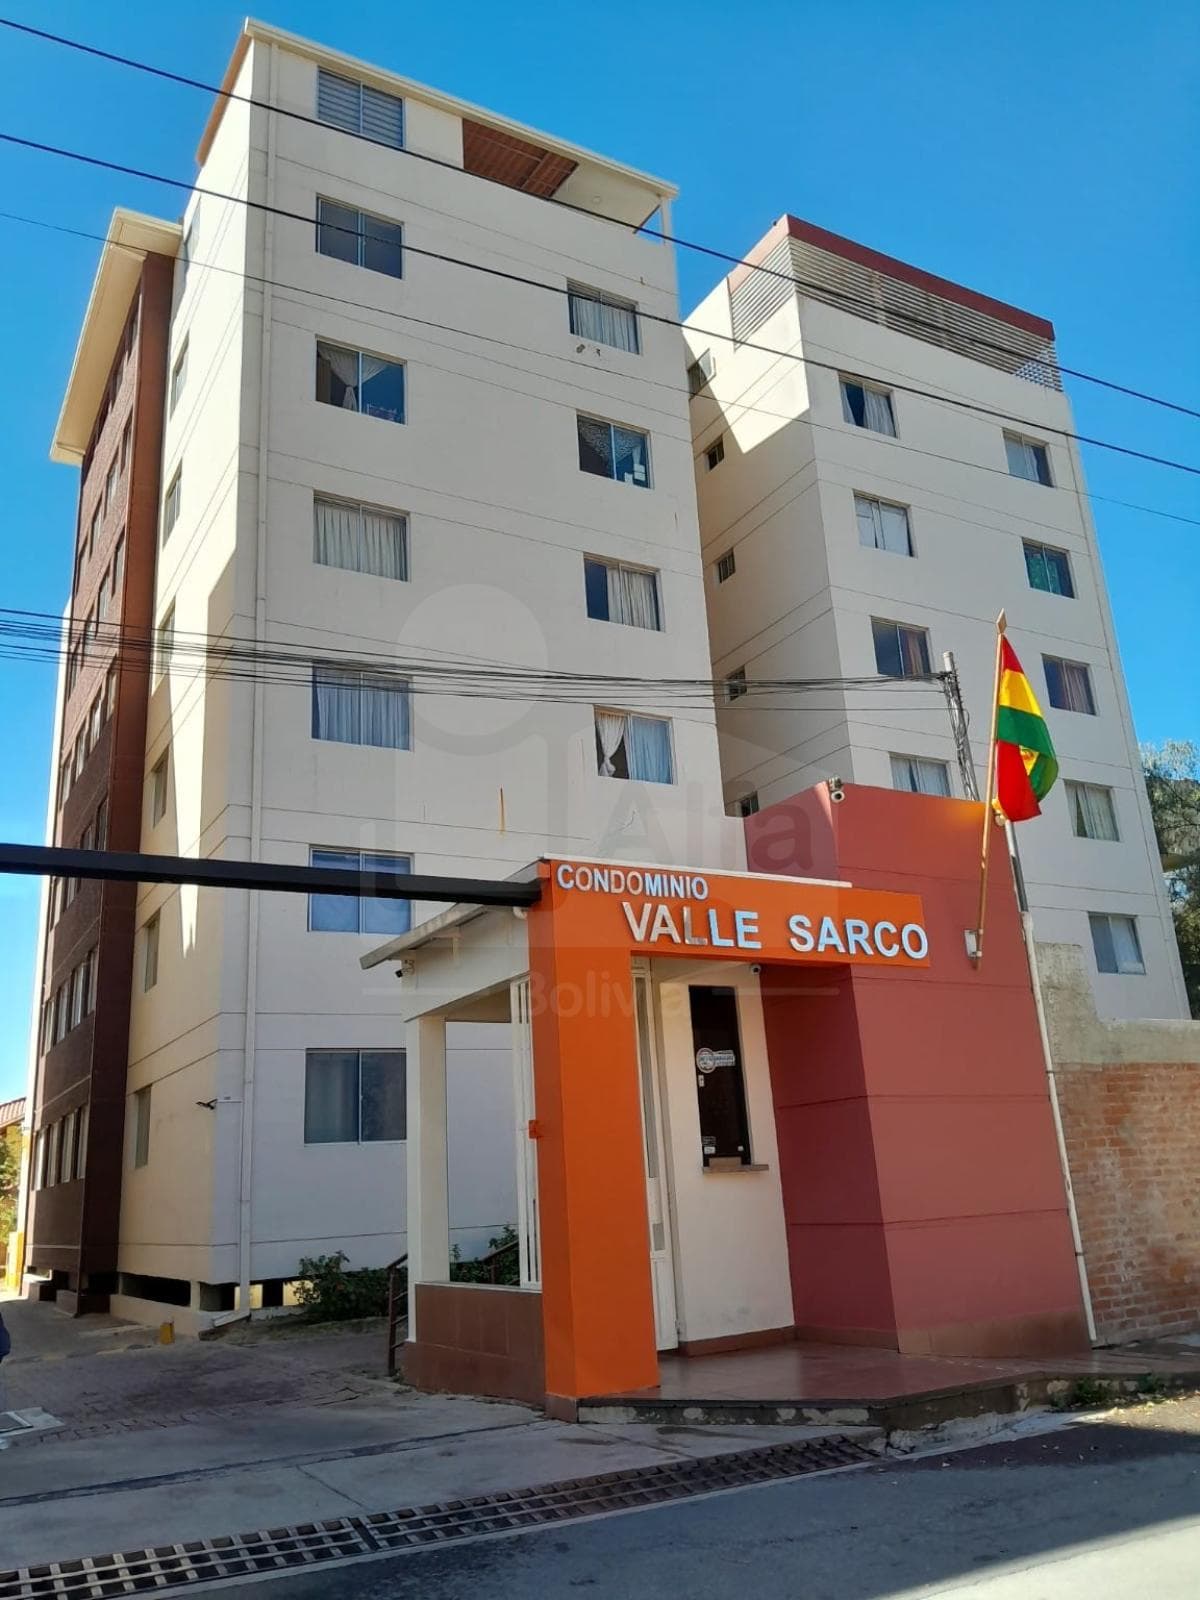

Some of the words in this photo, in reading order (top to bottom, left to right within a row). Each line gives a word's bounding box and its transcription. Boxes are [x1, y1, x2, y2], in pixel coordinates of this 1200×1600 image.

[556, 864, 708, 900] CONDOMINIO
[622, 901, 762, 950] VALLE
[788, 914, 929, 960] SARCO
